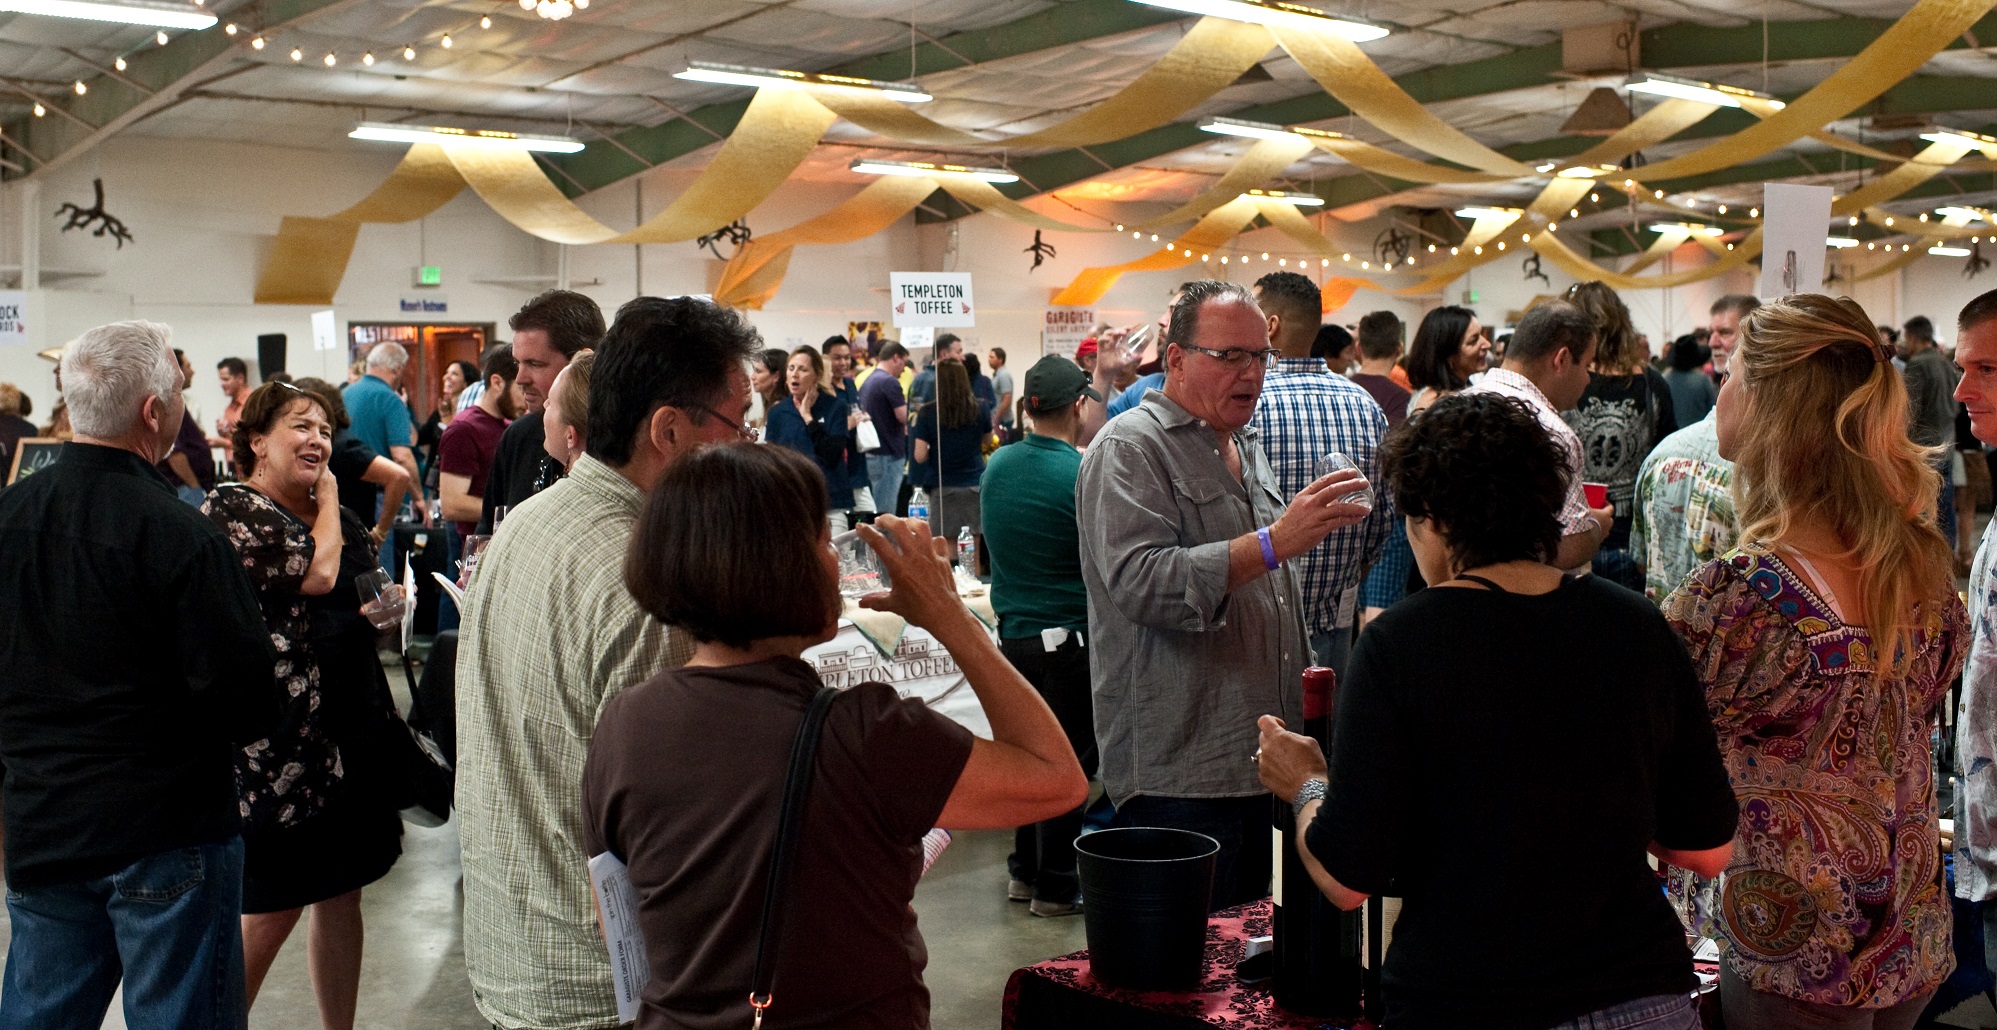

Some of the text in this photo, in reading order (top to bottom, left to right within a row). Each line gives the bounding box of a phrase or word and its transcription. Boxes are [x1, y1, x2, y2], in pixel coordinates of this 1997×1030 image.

[901, 284, 963, 298] TEMPLETON
[914, 301, 953, 314] TOFFEE
[820, 665, 893, 688] PLETON
